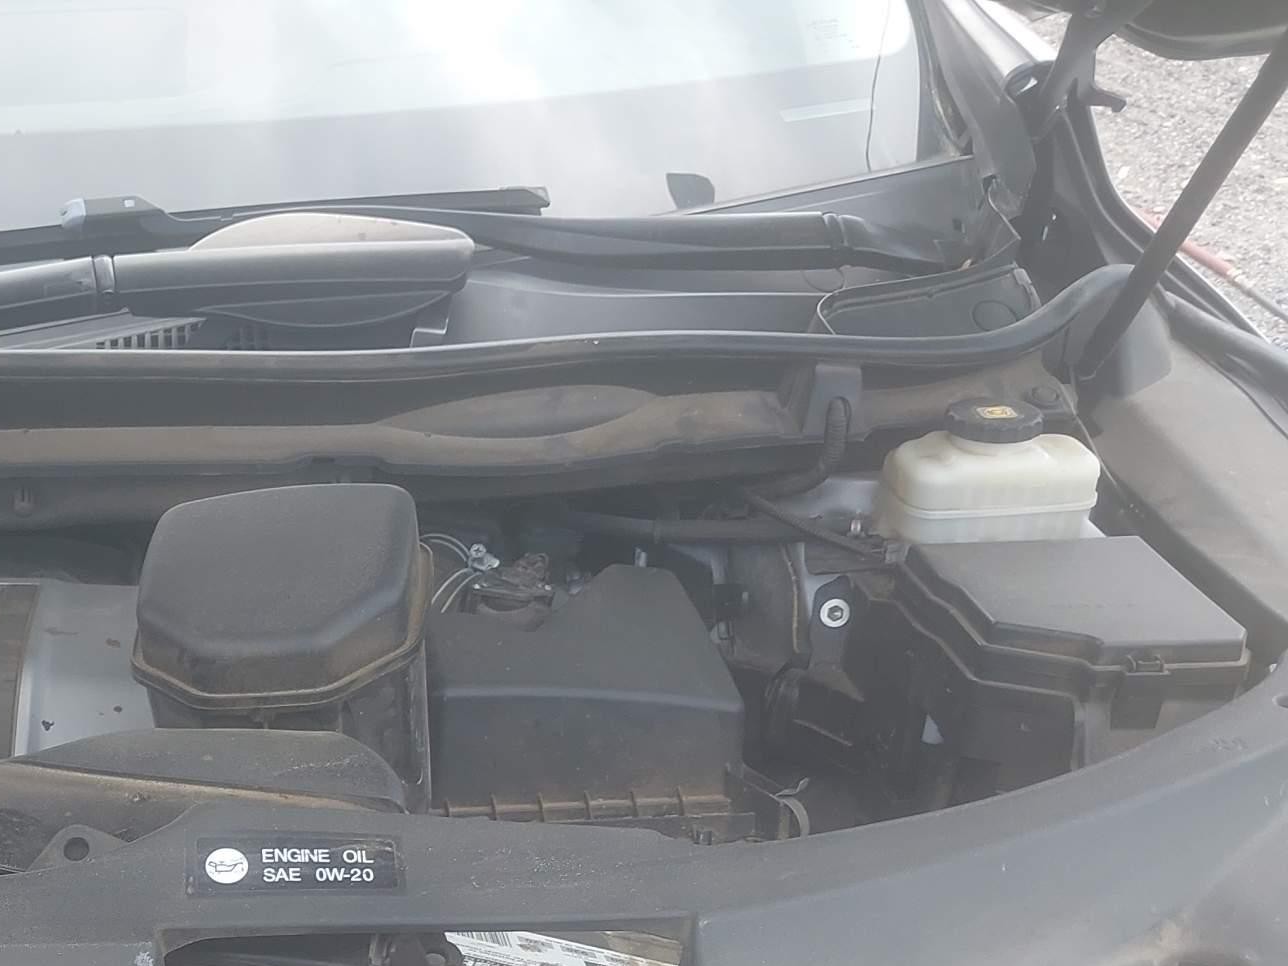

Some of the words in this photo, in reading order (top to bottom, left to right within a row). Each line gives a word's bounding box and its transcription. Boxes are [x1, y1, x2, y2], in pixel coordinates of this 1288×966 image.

[261, 848, 331, 863] ENGINE
[342, 849, 374, 864] OIL
[262, 867, 302, 882] SAE
[315, 867, 374, 882] 0W-20
